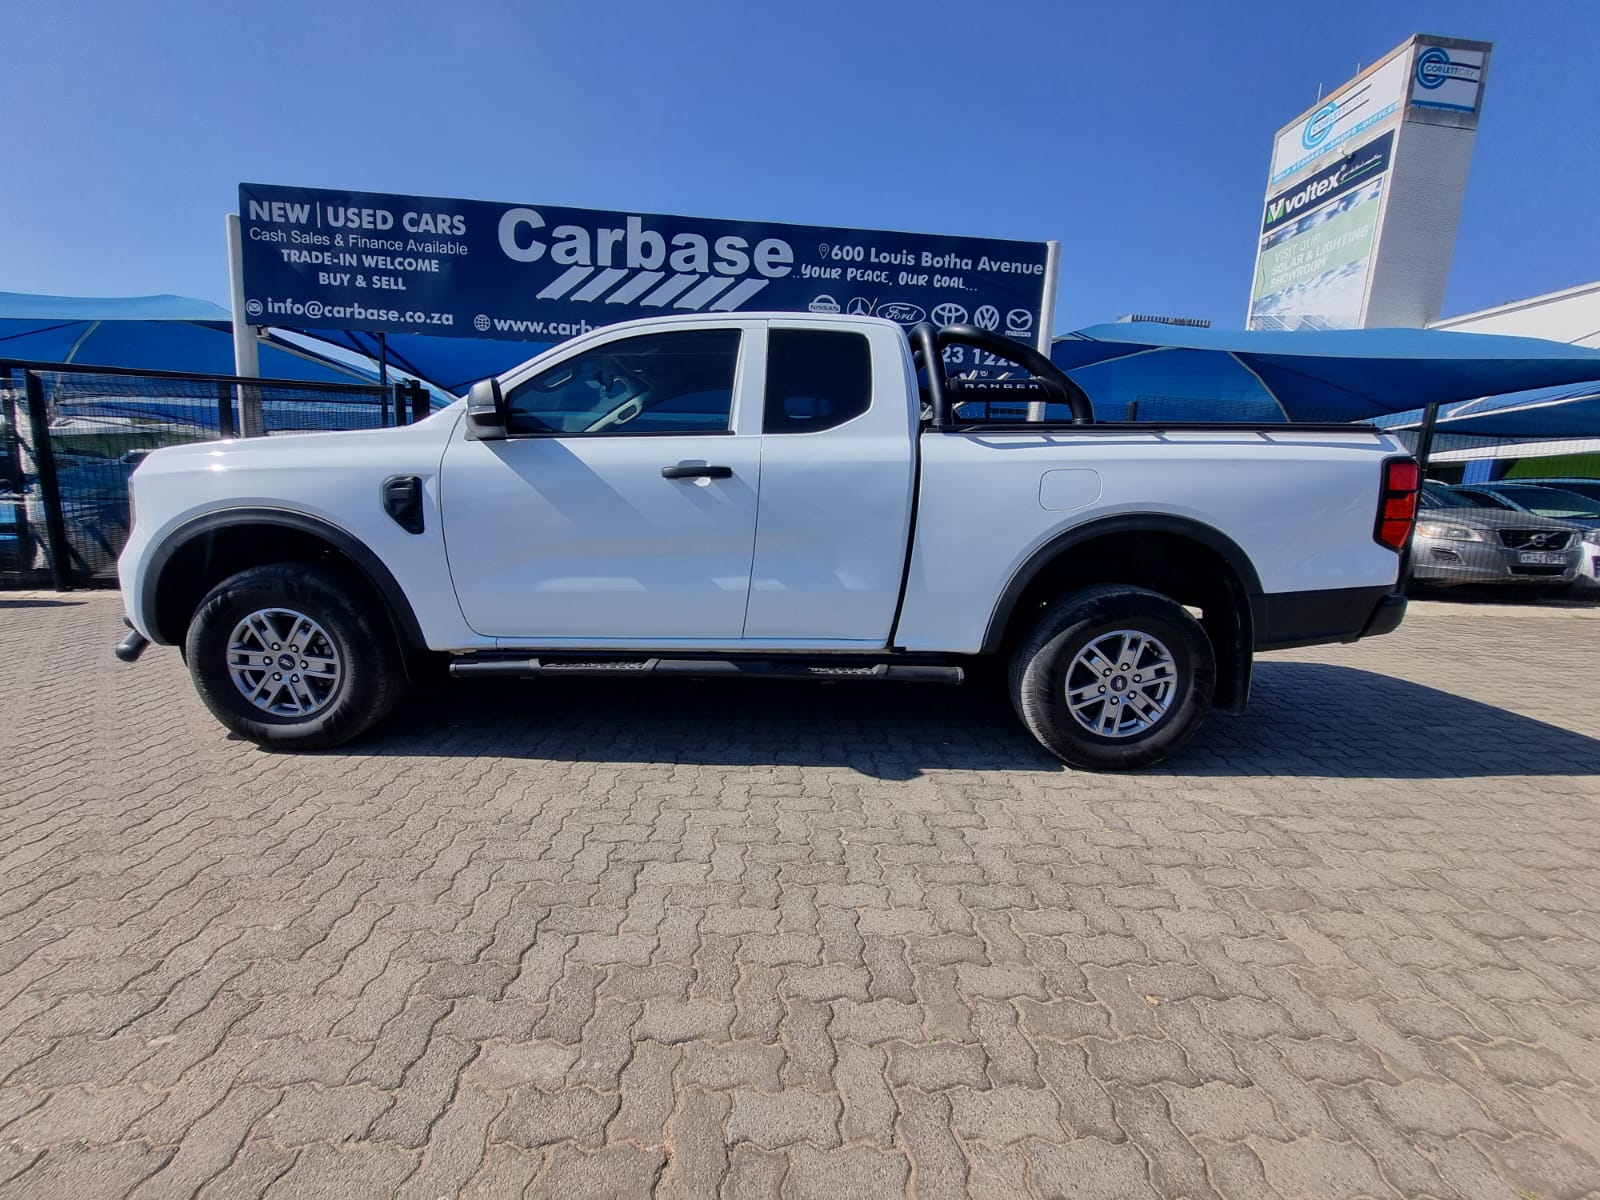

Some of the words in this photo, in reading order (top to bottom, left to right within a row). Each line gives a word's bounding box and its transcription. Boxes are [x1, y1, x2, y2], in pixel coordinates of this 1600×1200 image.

[1286, 171, 1341, 214] voltex
[249, 200, 310, 224] NEW
[327, 206, 394, 230] USED
[402, 211, 467, 236] CARS
[249, 227, 287, 242] Cash
[291, 230, 330, 246] Sales
[334, 233, 344, 247] &
[349, 235, 403, 251] Finance
[407, 239, 468, 256] Available
[497, 207, 794, 278] Carbase
[1271, 254, 1304, 276] SOLAR
[1316, 225, 1369, 256] LIGHTING
[1274, 243, 1298, 261] VISIT
[1299, 233, 1321, 250] OUR
[281, 248, 358, 267] TRADE-IN
[361, 254, 439, 273] WELCOME
[831, 244, 865, 262] 600
[870, 247, 916, 266] Louis
[921, 251, 972, 270] Botha
[976, 255, 1044, 275] Avenue
[1270, 257, 1327, 288] SHOWROOM
[318, 271, 350, 287] BUY
[355, 274, 367, 288] &
[372, 276, 407, 290] SELL
[898, 271, 929, 286] OUR
[267, 297, 454, 326] info@carbase.co.za
[810, 304, 840, 312] NISSAN
[885, 305, 916, 321] Ford
[973, 348, 1020, 367] 12
[964, 382, 1039, 390] RANGER
